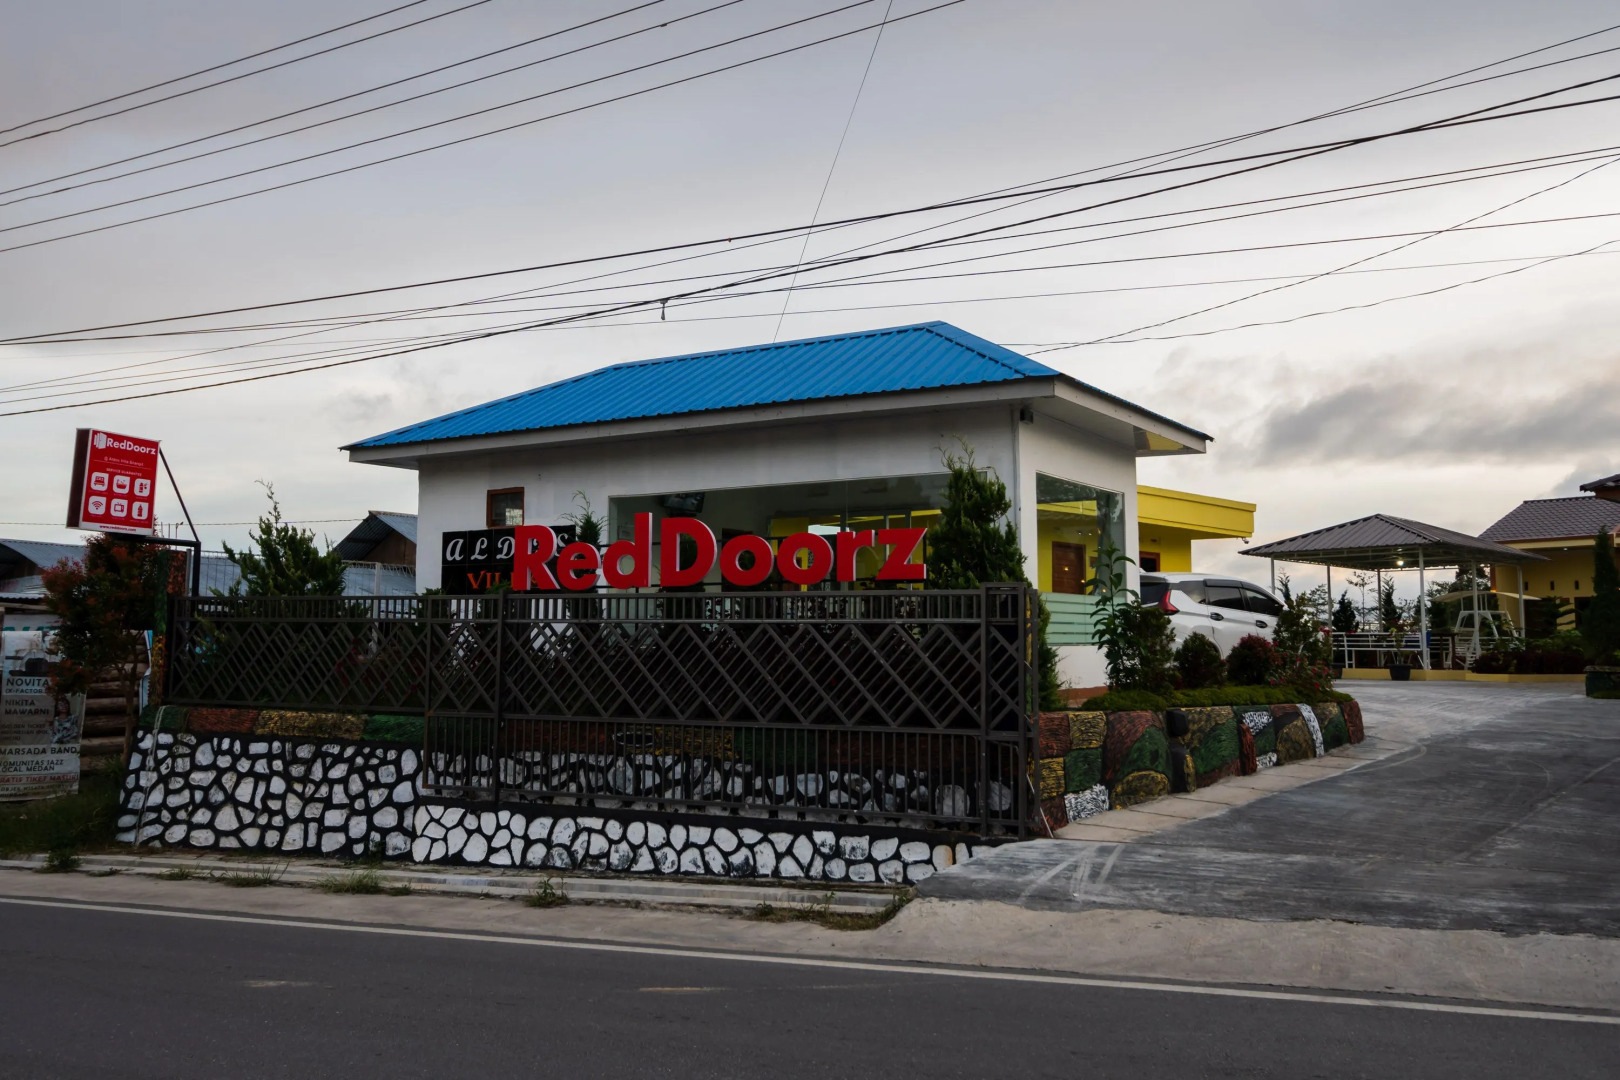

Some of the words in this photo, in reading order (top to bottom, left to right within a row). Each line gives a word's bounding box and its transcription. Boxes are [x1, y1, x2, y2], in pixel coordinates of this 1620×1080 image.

[106, 437, 156, 455] RedDoorz
[446, 532, 569, 561] ALDS
[511, 512, 928, 591] RedDoorz
[6, 678, 50, 687] NOVITA
[0, 747, 47, 755] MARSADA
